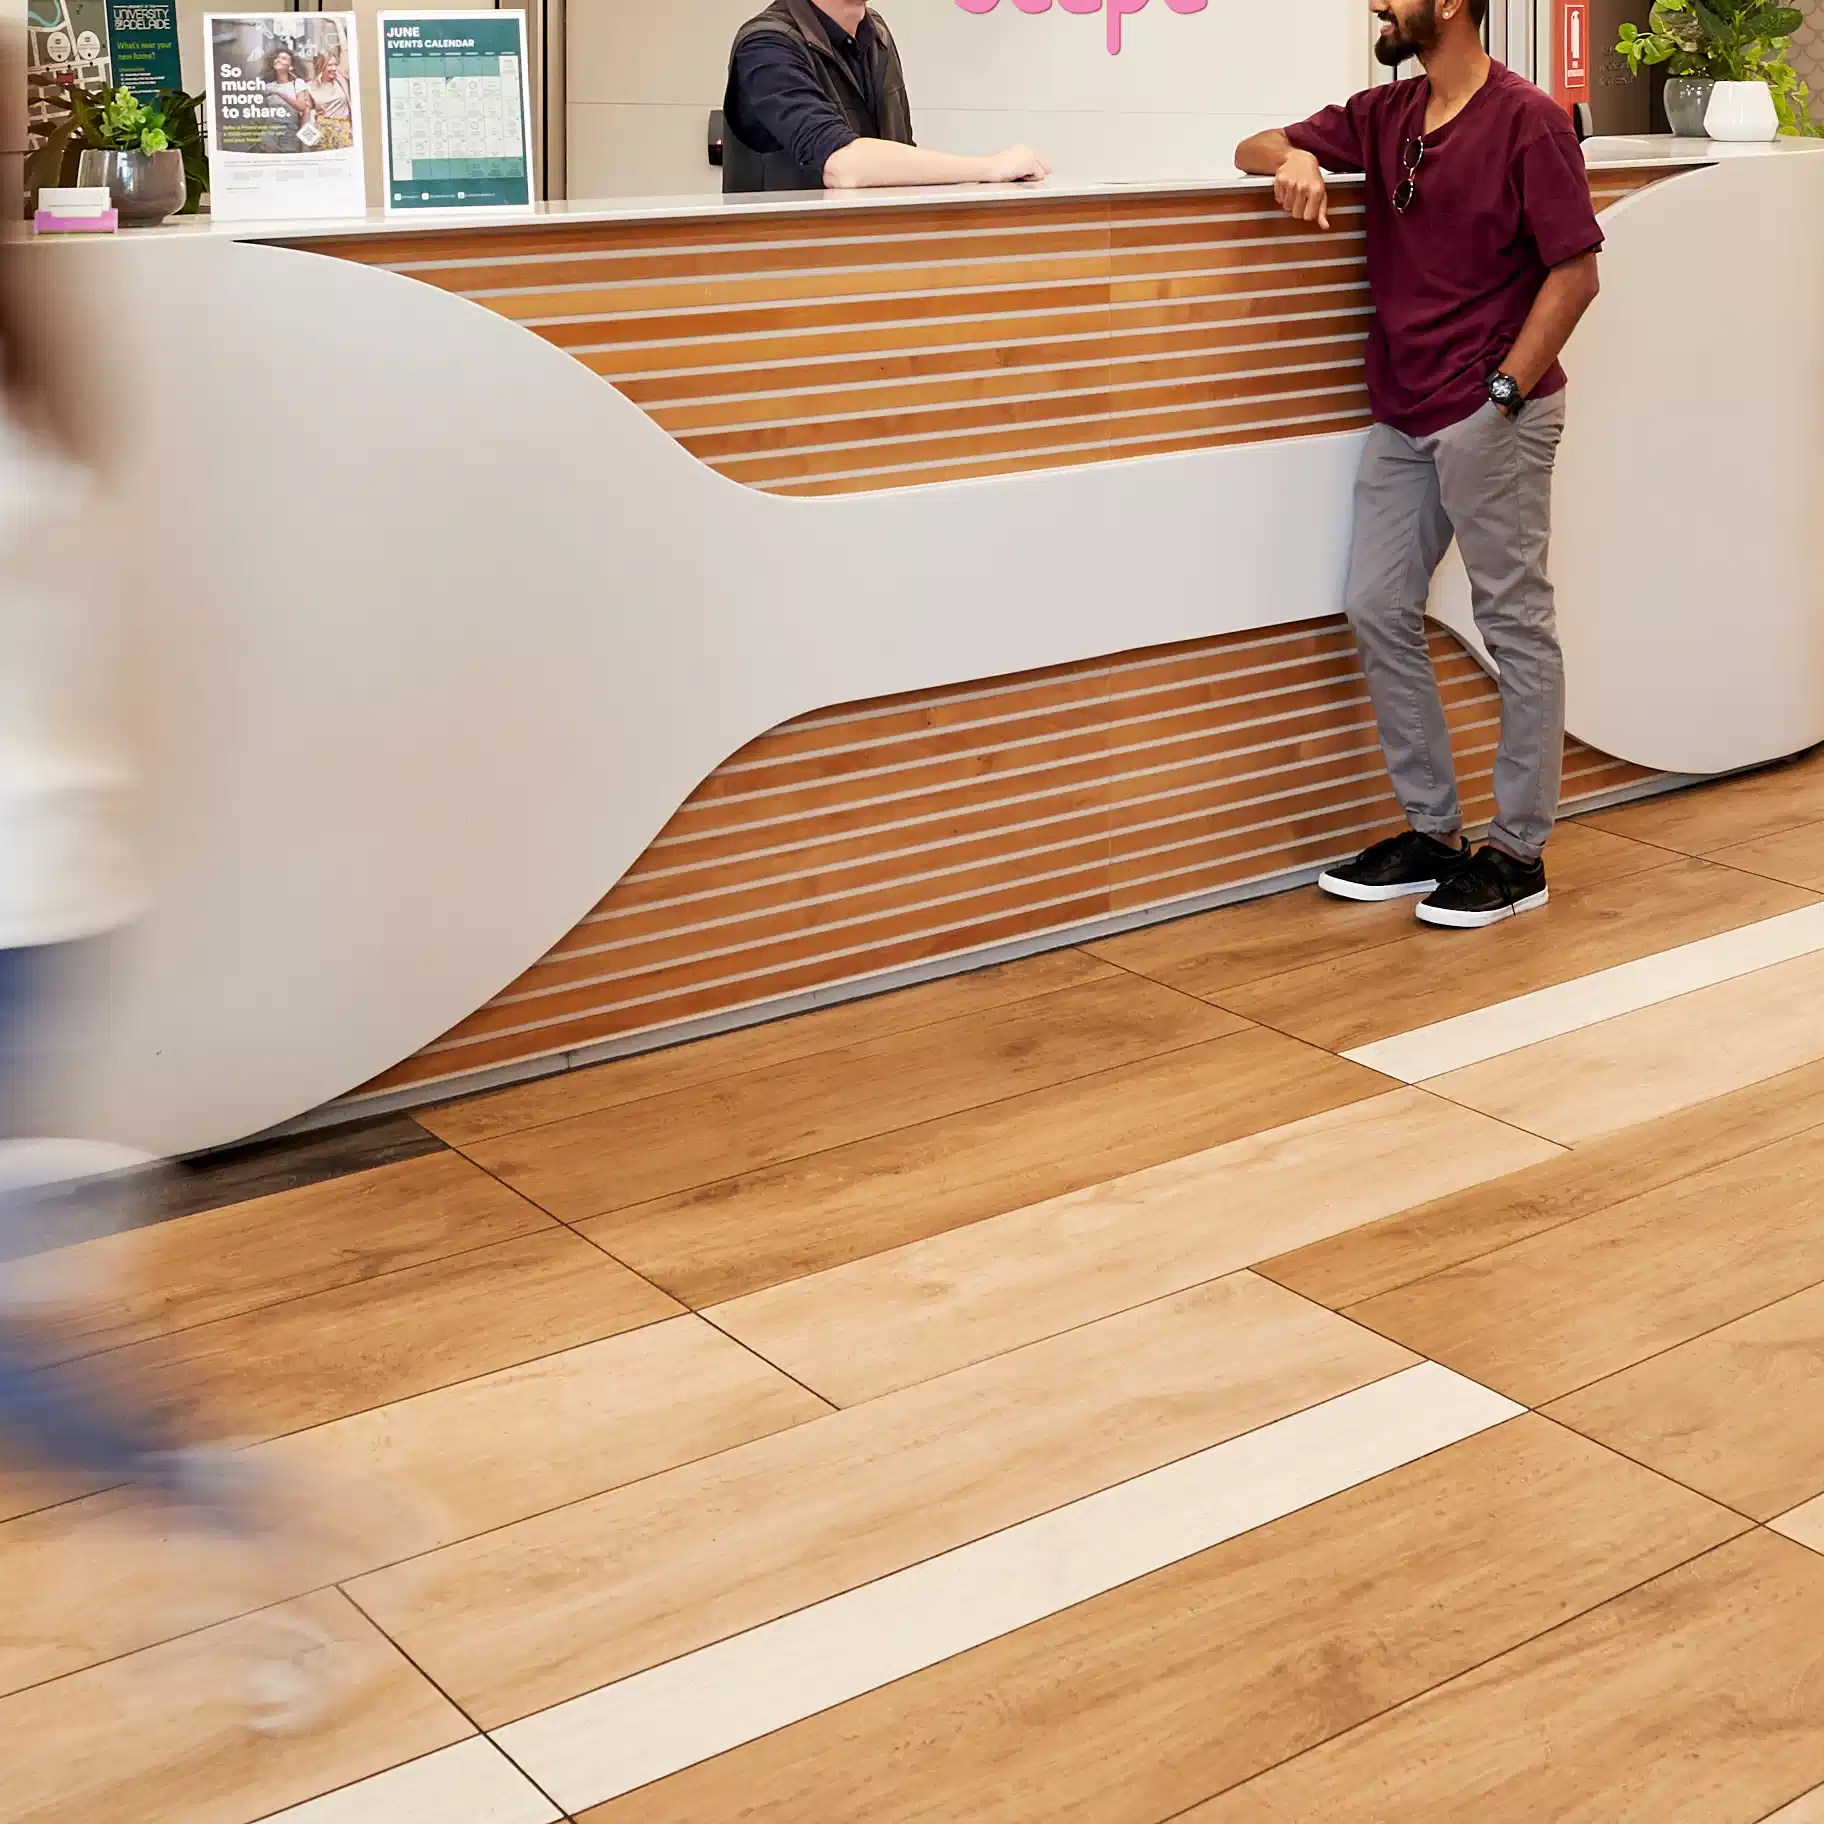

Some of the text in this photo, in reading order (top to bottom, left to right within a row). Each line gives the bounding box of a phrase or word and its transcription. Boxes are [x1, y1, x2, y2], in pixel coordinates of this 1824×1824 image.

[386, 26, 420, 38] JUNE
[387, 39, 475, 49] EVENTS CALENDAR
[220, 63, 242, 78] So
[221, 77, 266, 92] much
[222, 93, 264, 105] more
[222, 104, 292, 119] to share.
